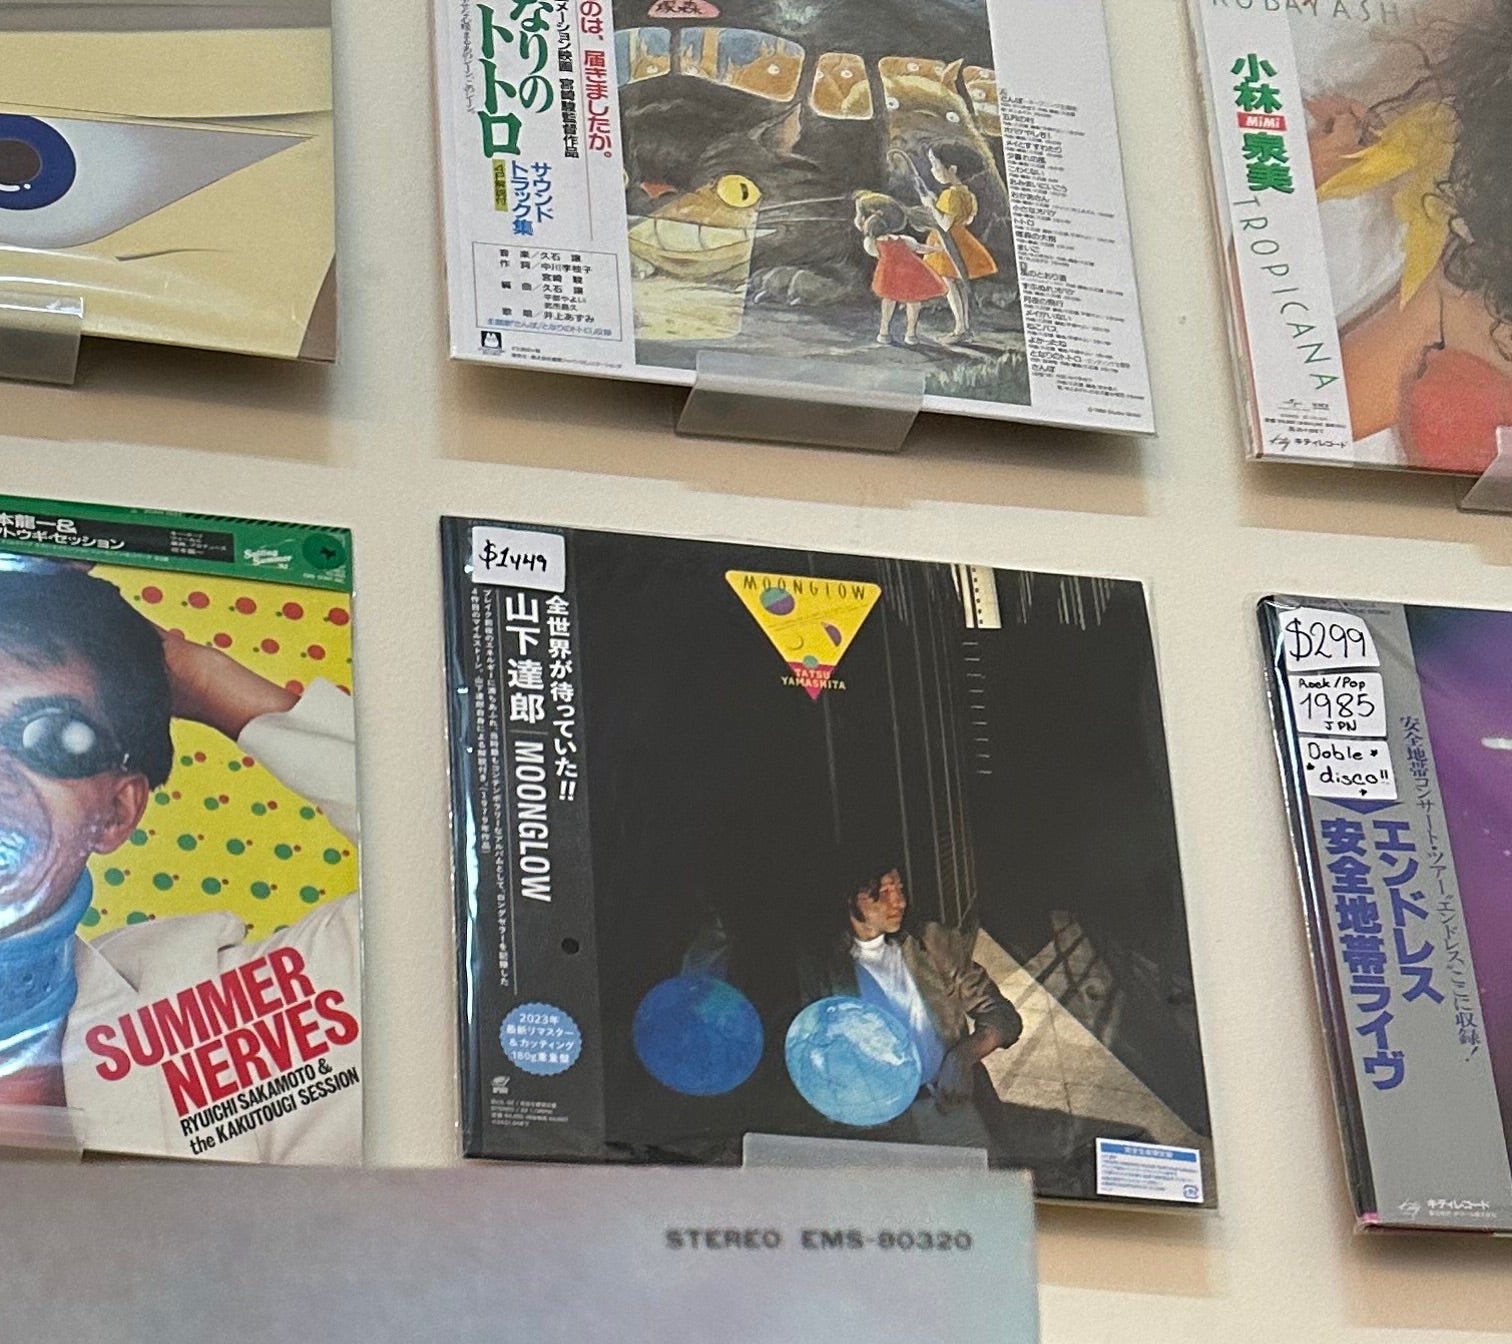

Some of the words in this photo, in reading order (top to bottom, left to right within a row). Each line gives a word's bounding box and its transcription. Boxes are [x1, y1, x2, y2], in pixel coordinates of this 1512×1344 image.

[1231, 52, 1284, 114] 小林
[530, 161, 555, 223] サウンド
[1242, 131, 1296, 194] 泉美
[1232, 195, 1338, 391] TROPICANA
[477, 538, 548, 573] $1449
[505, 591, 546, 725] 山下達郎
[1285, 617, 1366, 662] $299
[780, 675, 847, 691] YAMASHITA
[794, 668, 831, 680] TATSU
[1300, 692, 1376, 719] 1985
[1324, 720, 1357, 731] JPN
[1307, 742, 1364, 761] Doble
[514, 740, 553, 903] MOONGLOW
[1372, 819, 1445, 1004] エンドレス
[1320, 817, 1405, 1091] 安全地帯ライヴ
[85, 946, 316, 1082] SUMMER
[161, 989, 360, 1118] NERVES
[179, 1097, 238, 1137] RYUICHI
[238, 1064, 316, 1110] SAKAMOTO
[318, 1057, 333, 1075] &
[189, 1133, 217, 1156] the
[217, 1099, 298, 1144] KAKUTOUGI
[299, 1066, 360, 1107] SESSION
[665, 1227, 782, 1250] STEREO
[800, 1228, 975, 1251] EMS-80320
